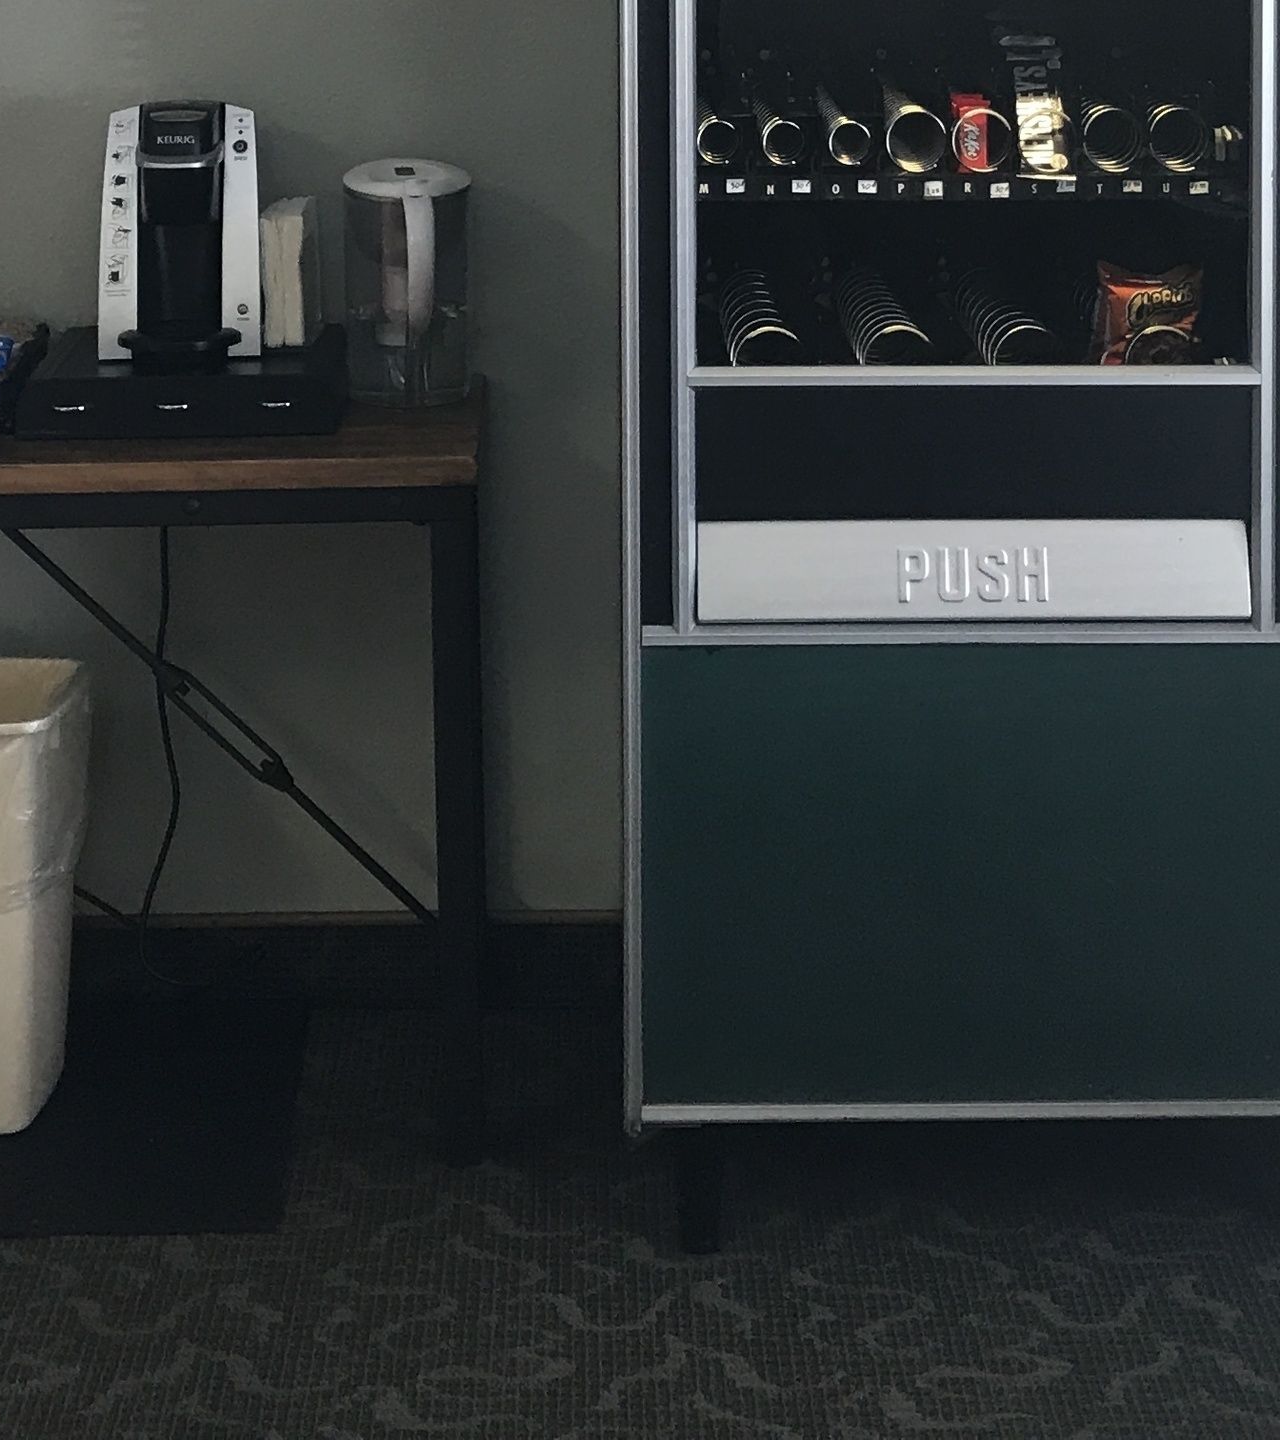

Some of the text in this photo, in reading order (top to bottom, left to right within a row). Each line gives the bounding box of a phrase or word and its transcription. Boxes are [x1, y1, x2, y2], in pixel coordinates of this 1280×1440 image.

[156, 135, 195, 145] KEURIG
[698, 182, 709, 194] M
[766, 184, 775, 195] N
[831, 183, 840, 195] O
[898, 183, 905, 194] P
[964, 182, 972, 193] R
[1031, 183, 1038, 194] S
[1096, 183, 1103, 194] T
[1162, 182, 1170, 193] U
[896, 546, 1050, 604] PUSH
